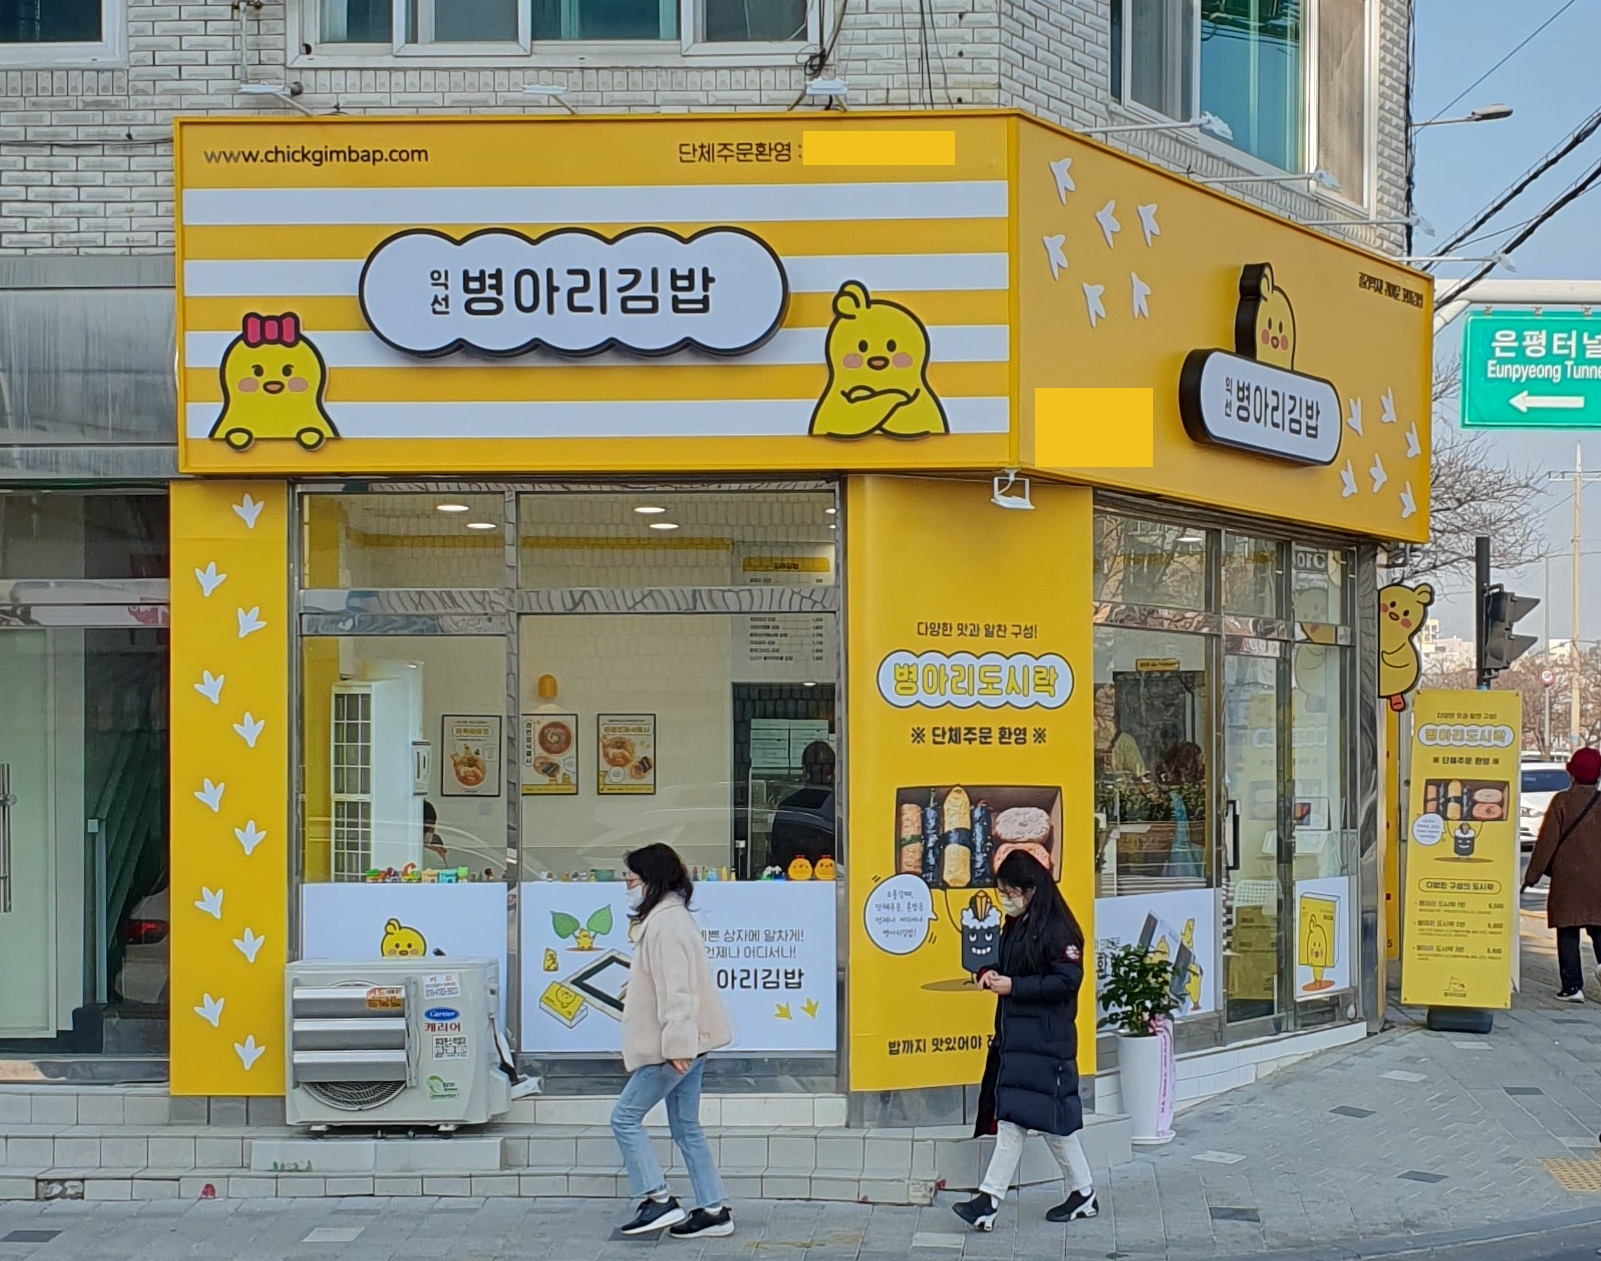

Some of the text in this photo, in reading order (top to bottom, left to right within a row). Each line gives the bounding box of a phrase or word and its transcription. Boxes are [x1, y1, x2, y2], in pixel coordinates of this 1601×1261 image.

[203, 145, 429, 167] www.chickgimbap.com
[678, 142, 792, 163] 단체주문환영
[462, 267, 717, 316] 병아리김밥
[1487, 359, 1562, 383] Eunpyeong
[1236, 379, 1321, 439] 병아리김밥
[916, 621, 1038, 639] 다양한 맛과 알찬 구성!
[893, 663, 1059, 698] 병아리도시락
[931, 726, 1028, 746] 단체주문 환영
[724, 929, 760, 943] 상자에
[764, 929, 804, 943] 알차게!
[744, 945, 797, 959] 어디서나!
[888, 1038, 927, 1055] 밥까지
[931, 1035, 983, 1053] 맛있어야
